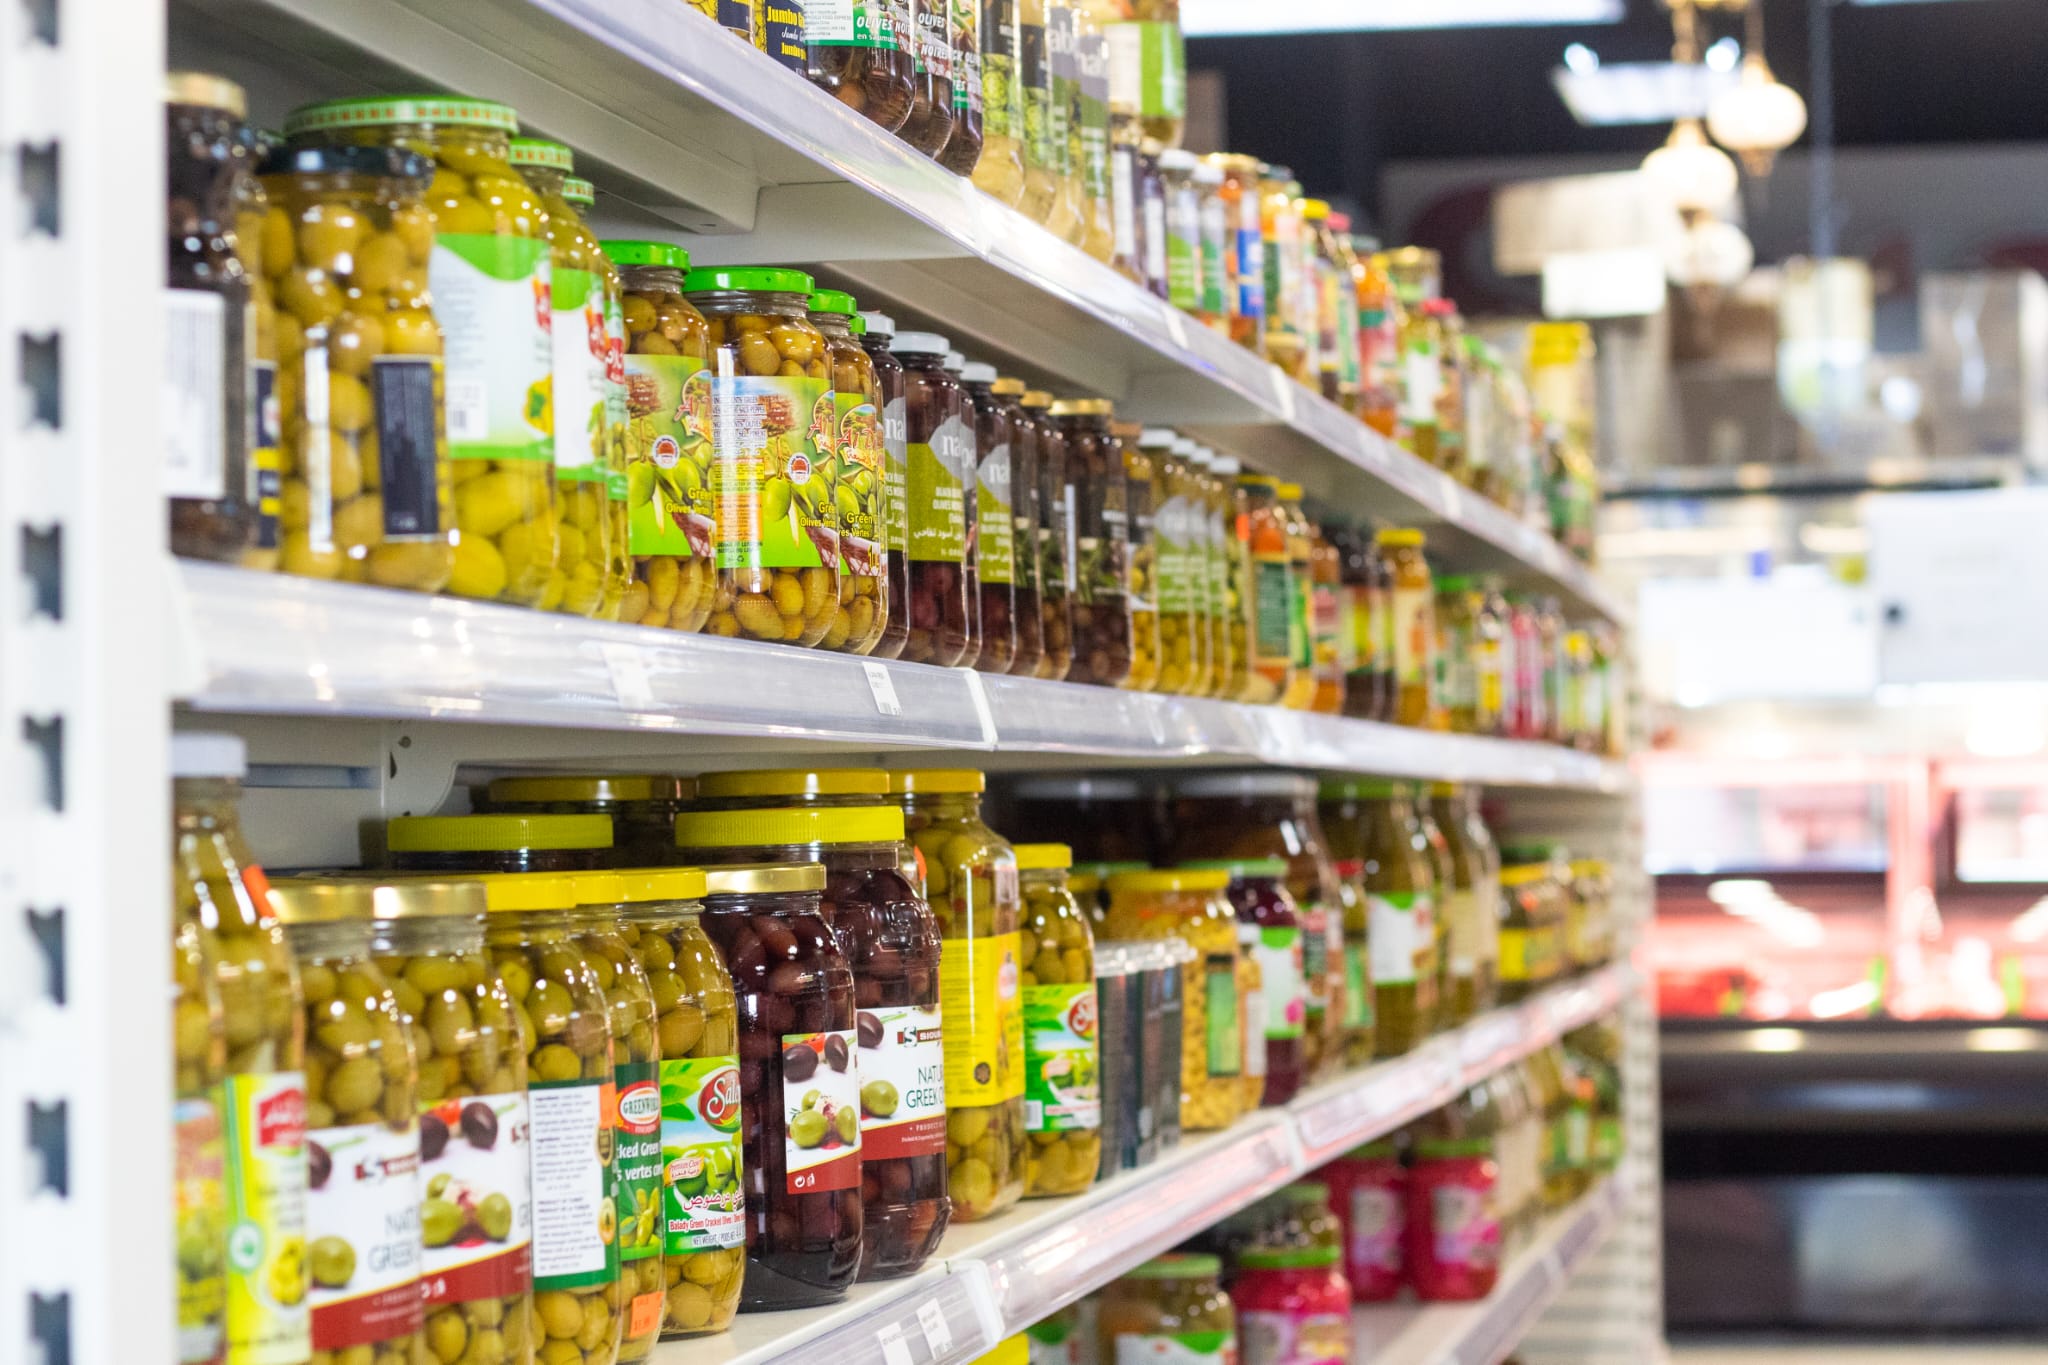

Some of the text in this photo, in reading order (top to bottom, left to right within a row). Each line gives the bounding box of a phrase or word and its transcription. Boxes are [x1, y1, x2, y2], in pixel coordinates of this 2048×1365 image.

[767, 5, 797, 26] Jumbo
[918, 13, 946, 28] OLIVES
[857, 16, 893, 31] OLIVES
[800, 516, 821, 528] Olives
[846, 511, 872, 526] Green
[625, 1164, 653, 1181] vertes
[670, 1219, 690, 1232] Balady
[690, 1218, 705, 1229] Green
